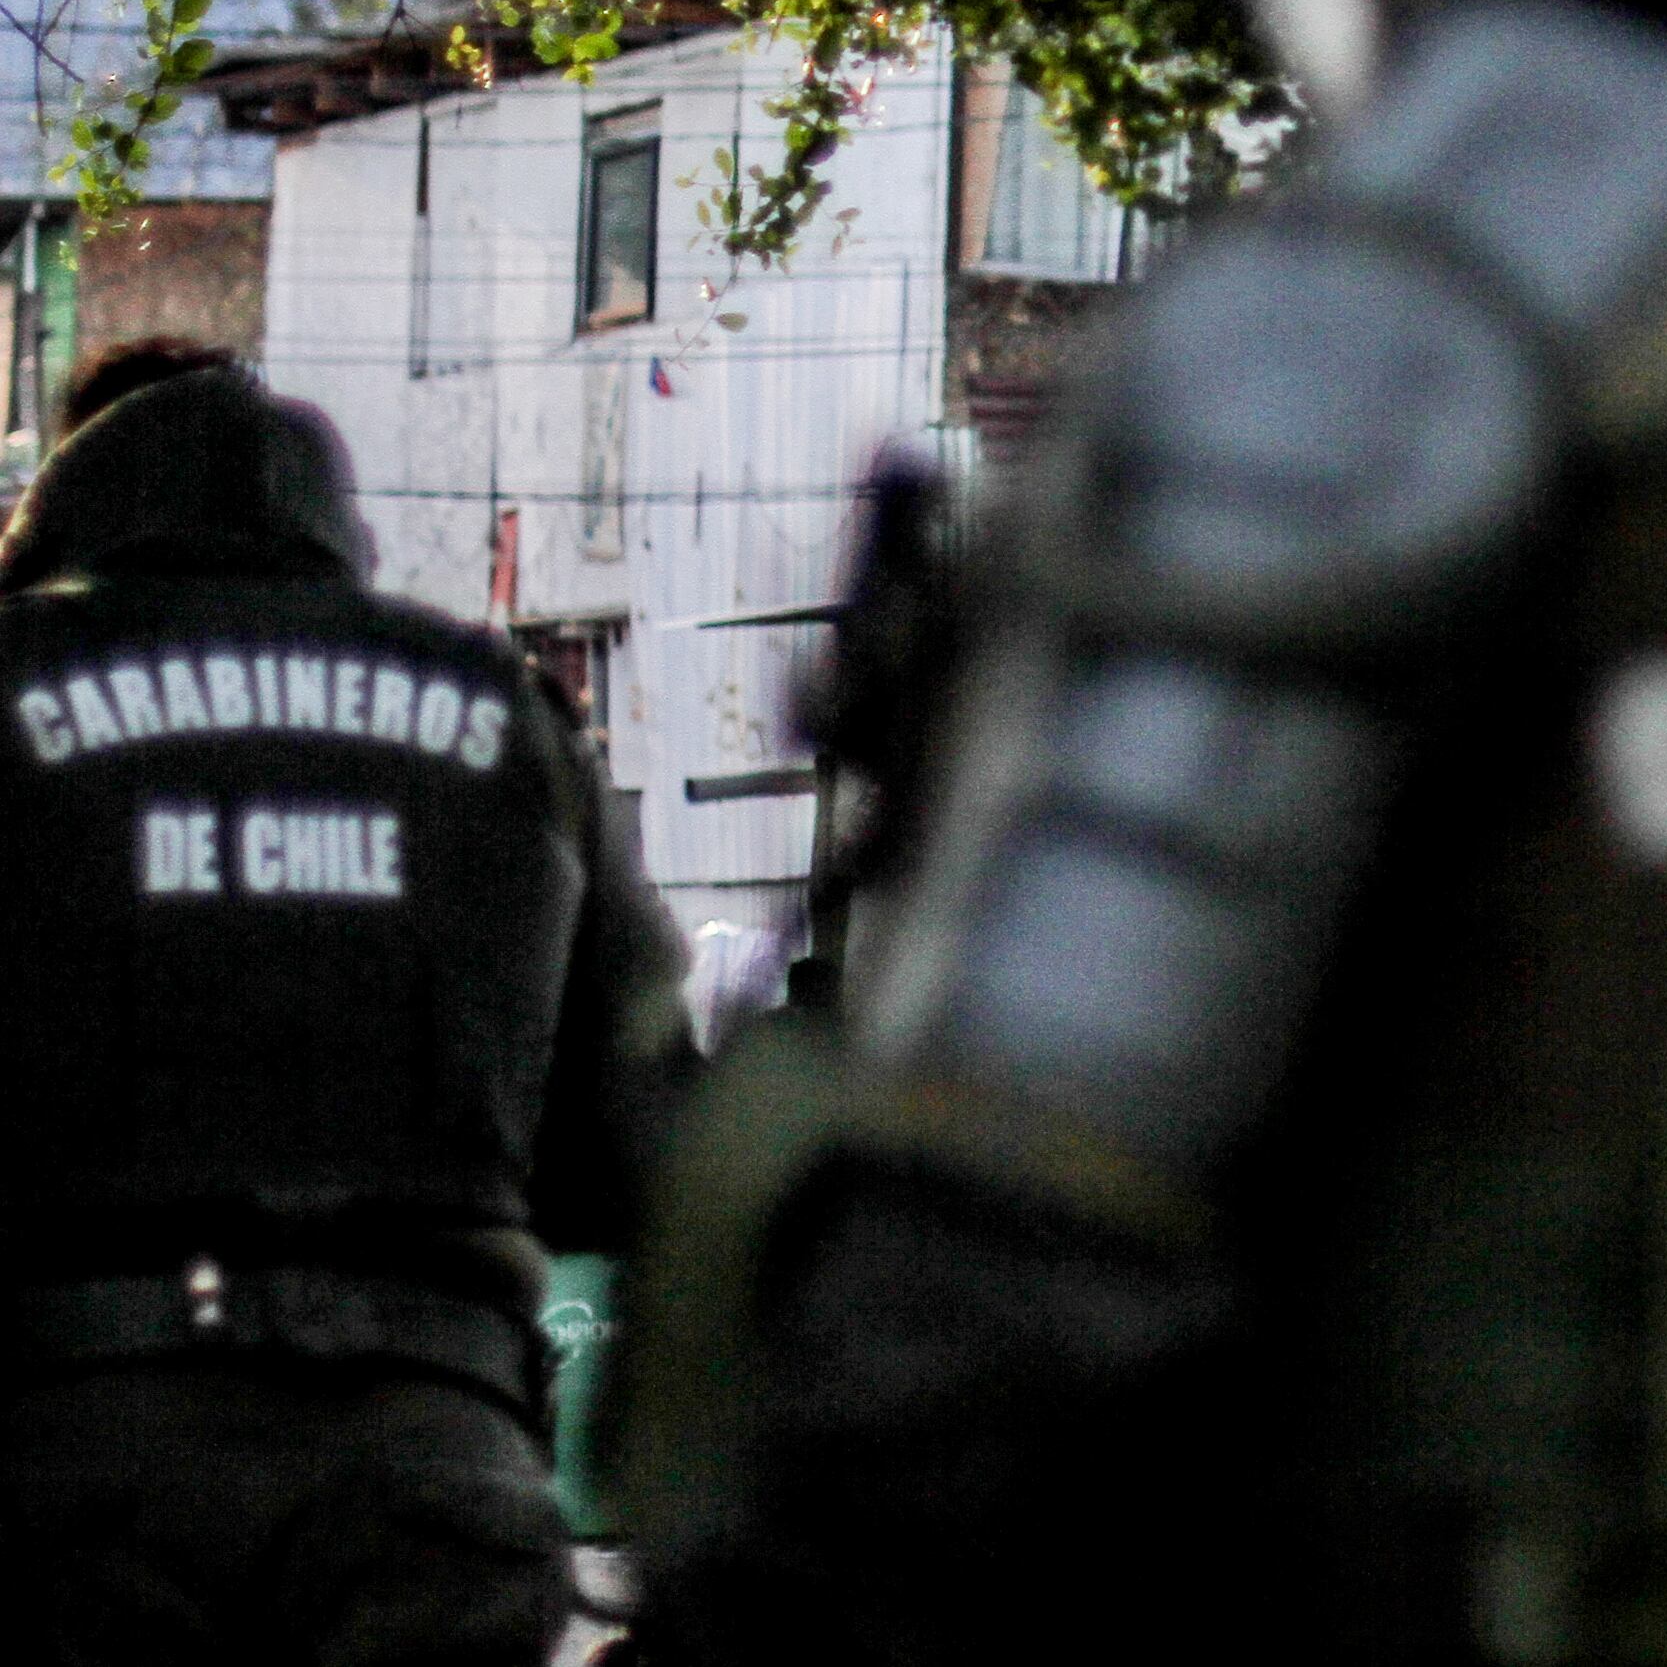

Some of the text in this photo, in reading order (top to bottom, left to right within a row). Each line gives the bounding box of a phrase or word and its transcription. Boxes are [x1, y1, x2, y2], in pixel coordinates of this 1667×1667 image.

[18, 656, 507, 771] CARABINEROS
[145, 812, 402, 896] DE CHILE
